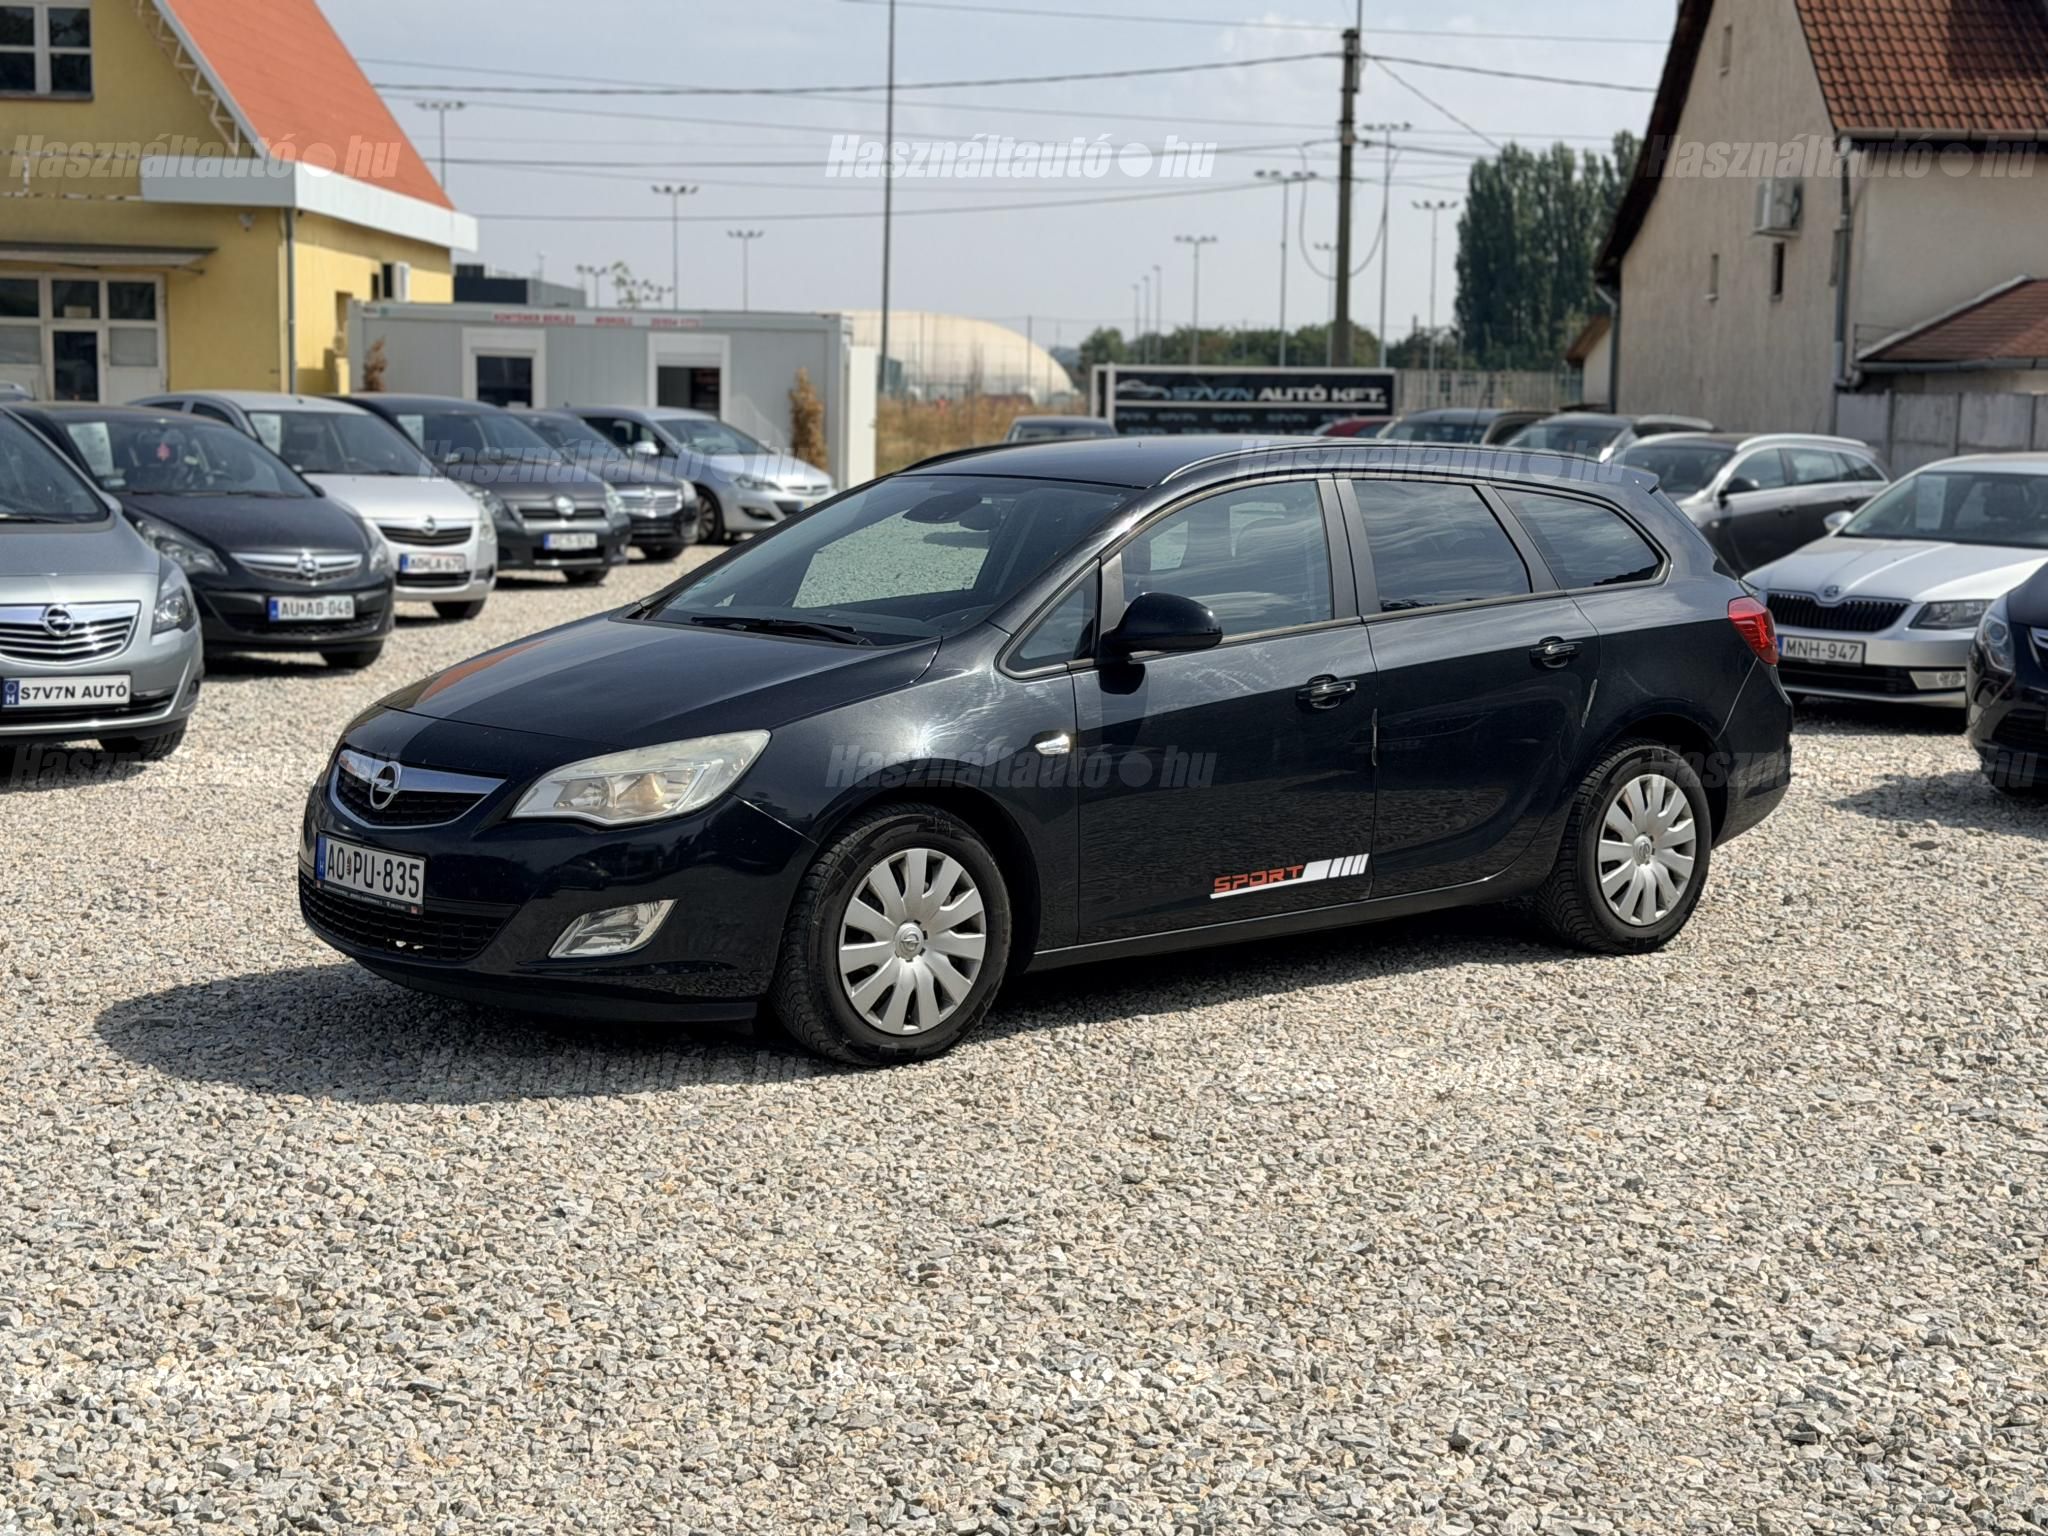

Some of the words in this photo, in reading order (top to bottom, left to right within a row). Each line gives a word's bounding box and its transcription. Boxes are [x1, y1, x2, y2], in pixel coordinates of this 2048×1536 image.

[1257, 384, 1328, 402] AUTÓ
[1332, 387, 1386, 402] KFT.
[1786, 639, 1858, 661] MNH-947
[20, 686, 76, 700] S7V7N
[81, 681, 127, 699] AUTÓ
[1214, 864, 1304, 894] SPORT
